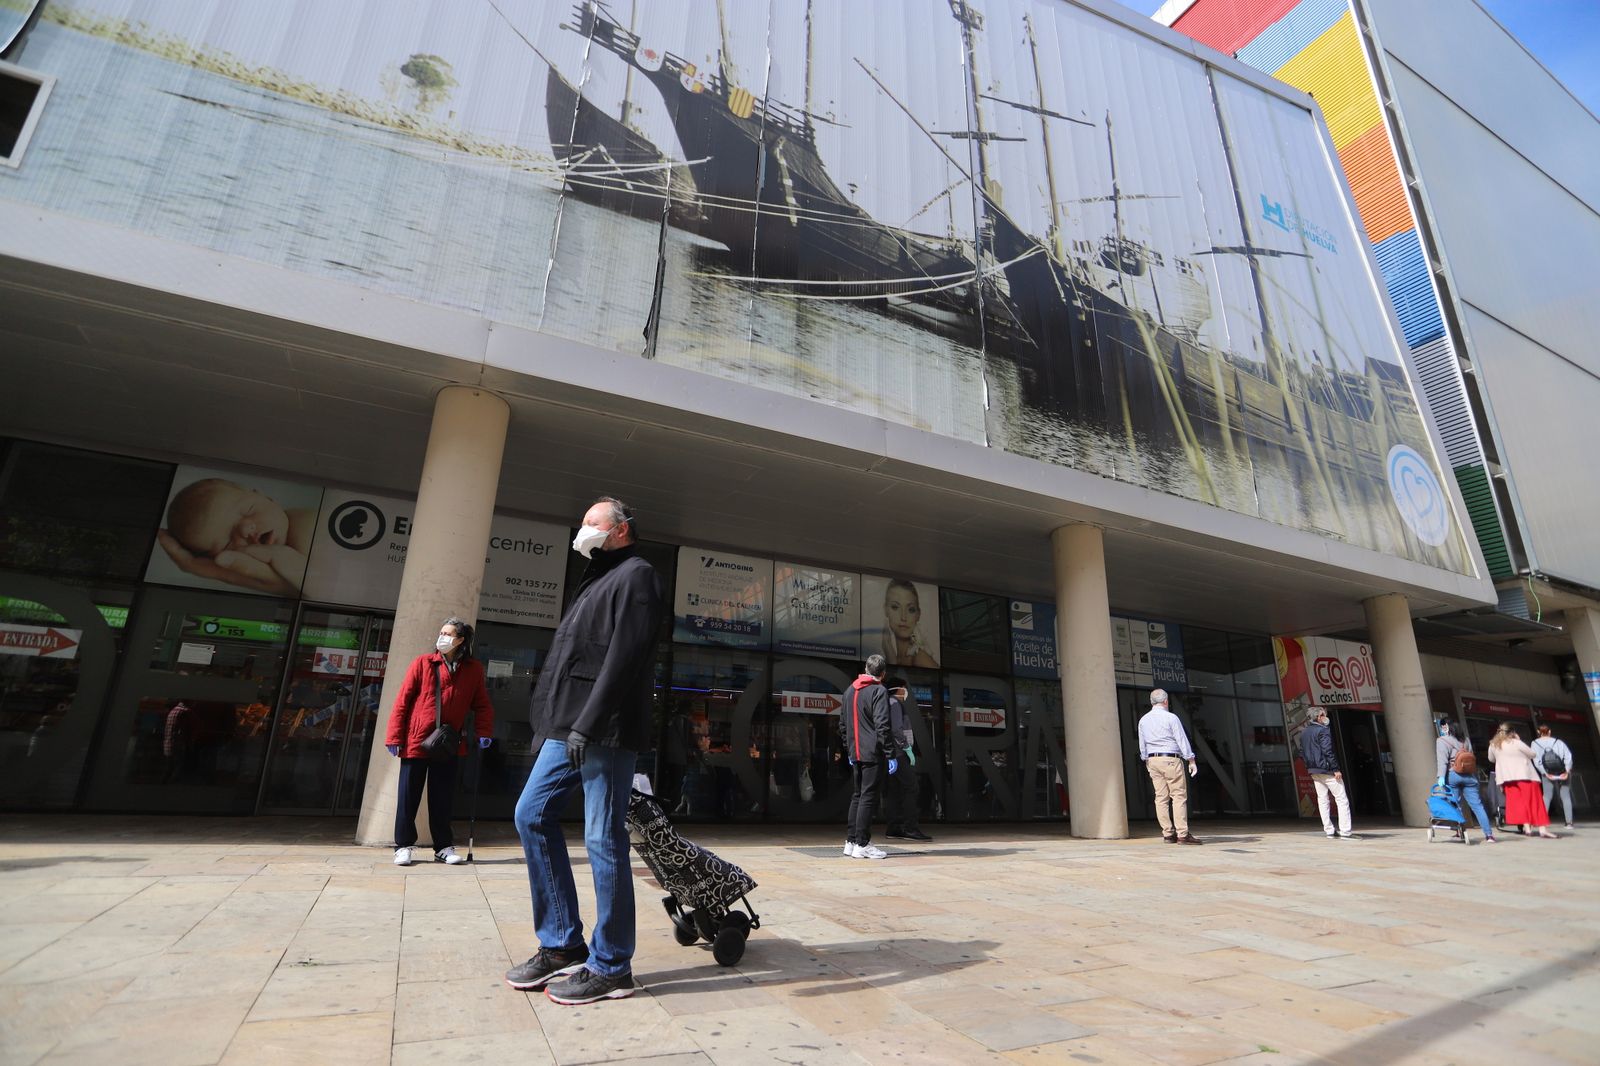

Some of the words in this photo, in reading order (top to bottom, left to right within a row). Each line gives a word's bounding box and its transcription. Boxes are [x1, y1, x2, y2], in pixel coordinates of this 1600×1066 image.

[1301, 227, 1338, 256] HUELVA
[505, 577, 522, 587] 902
[525, 579, 540, 589] 135
[542, 581, 558, 591] 777
[481, 606, 555, 620] www.embryocenter.es
[798, 609, 838, 625] Integral
[710, 621, 722, 630] 959
[723, 623, 732, 631] 54
[2, 631, 59, 649] ENTRADA
[1014, 640, 1040, 654] Aceite
[1042, 643, 1053, 655] de
[1013, 652, 1055, 669] Huelva
[1153, 657, 1174, 669] Aceite
[1175, 660, 1184, 670] de
[1153, 668, 1186, 683] Huelva
[807, 698, 834, 709] ENTRADA
[976, 712, 998, 722] ENTRADA
